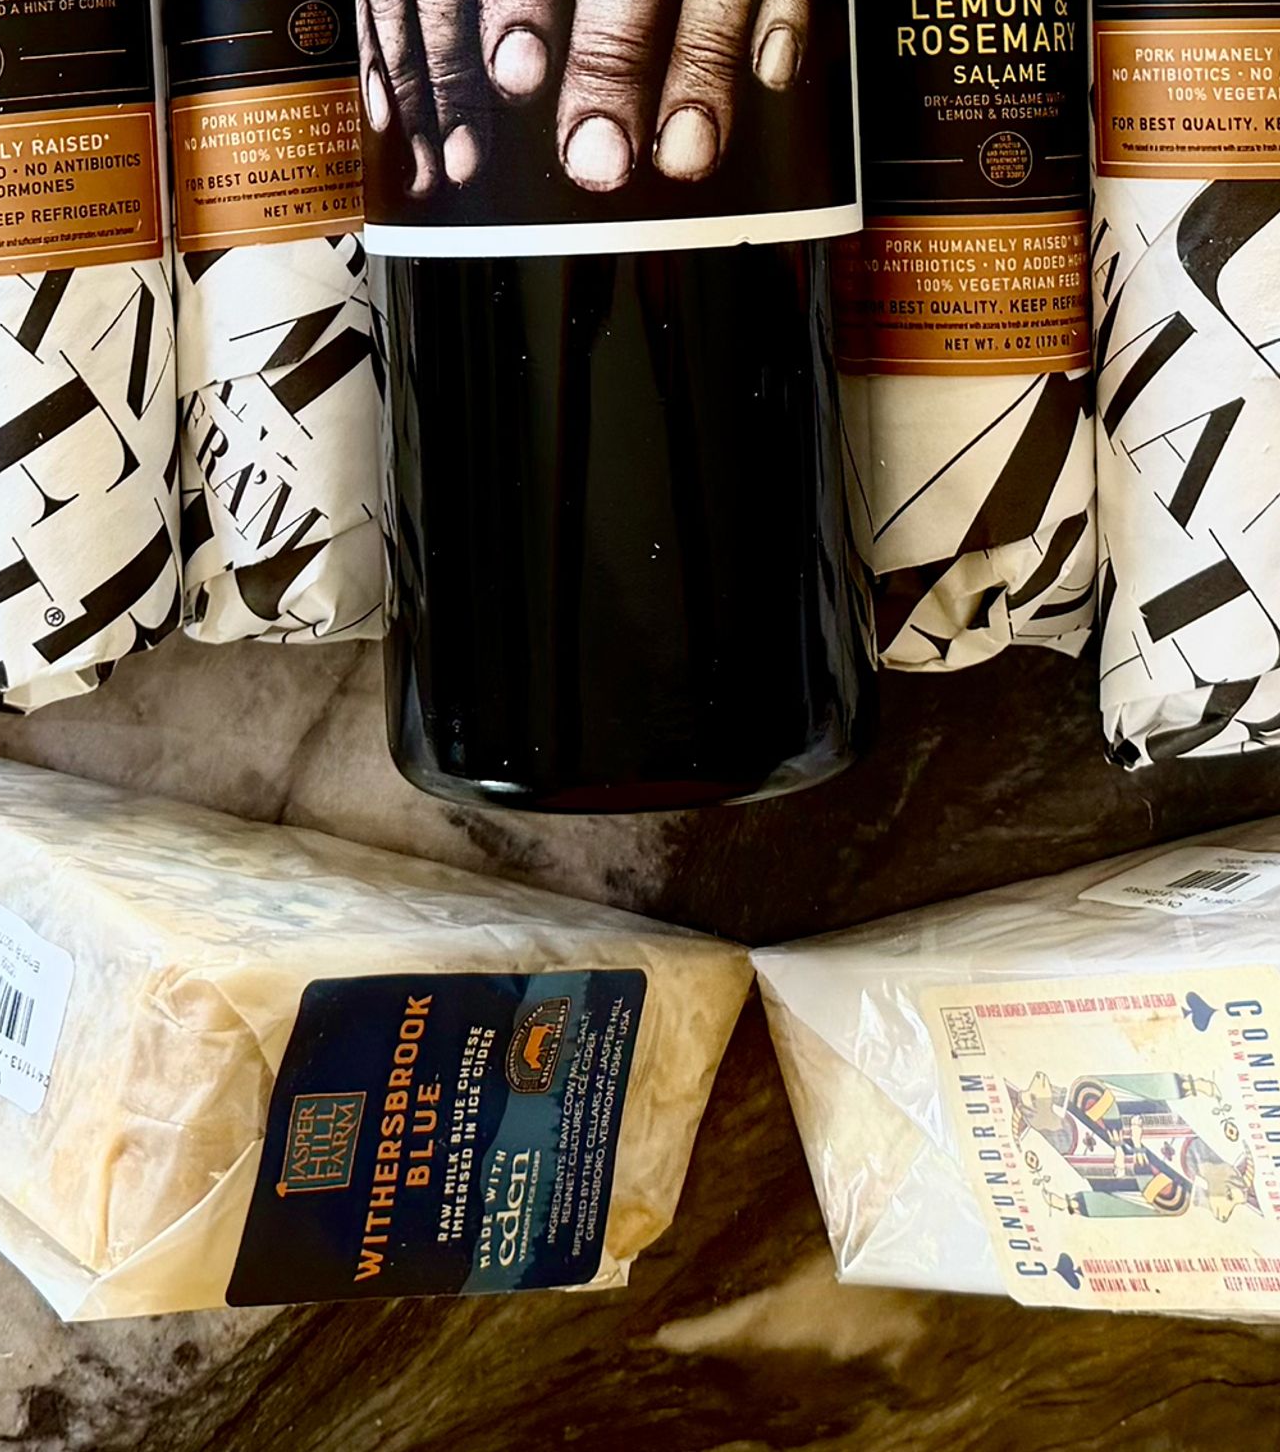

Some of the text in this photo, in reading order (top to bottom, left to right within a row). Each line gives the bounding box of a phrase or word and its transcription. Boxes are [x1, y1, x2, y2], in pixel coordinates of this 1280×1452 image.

[897, 22, 1074, 55] ROSEMARY
[1135, 47, 1272, 62] PORK HUMANELY
[953, 63, 1046, 84] SALAME
[1112, 68, 1127, 81] NO
[1132, 67, 1230, 81] ANTIBIOTICS
[1250, 67, 1271, 79] NO
[1168, 87, 1206, 100] 100%
[201, 103, 330, 130] PORK HUMANELY
[1112, 117, 1134, 129] FOR
[1140, 117, 1174, 130] BEST
[25, 162, 47, 176] NO
[53, 153, 140, 173] ANTIBIOTICS
[31, 199, 140, 222] REFRIGERATED
[886, 238, 1016, 253] PORK HUMANELY
[1227, 1029, 1243, 1060] RAW
[1237, 1072, 1256, 1112] MILK
[1247, 1121, 1269, 1159] GOAT
[289, 1105, 316, 1180] JASPER
[306, 1102, 338, 1179] HILL
[353, 994, 432, 1281] WITHERSBROOK
[404, 1082, 441, 1186] BLUE
[436, 1025, 483, 1241] RAW MILK BLUE CHEESE
[450, 1028, 496, 1239] IMMERSED IN ICE CIDER
[960, 1074, 1048, 1276] CONUNDRUM
[476, 1149, 507, 1269] MADE WITH
[495, 1148, 531, 1266] eden
